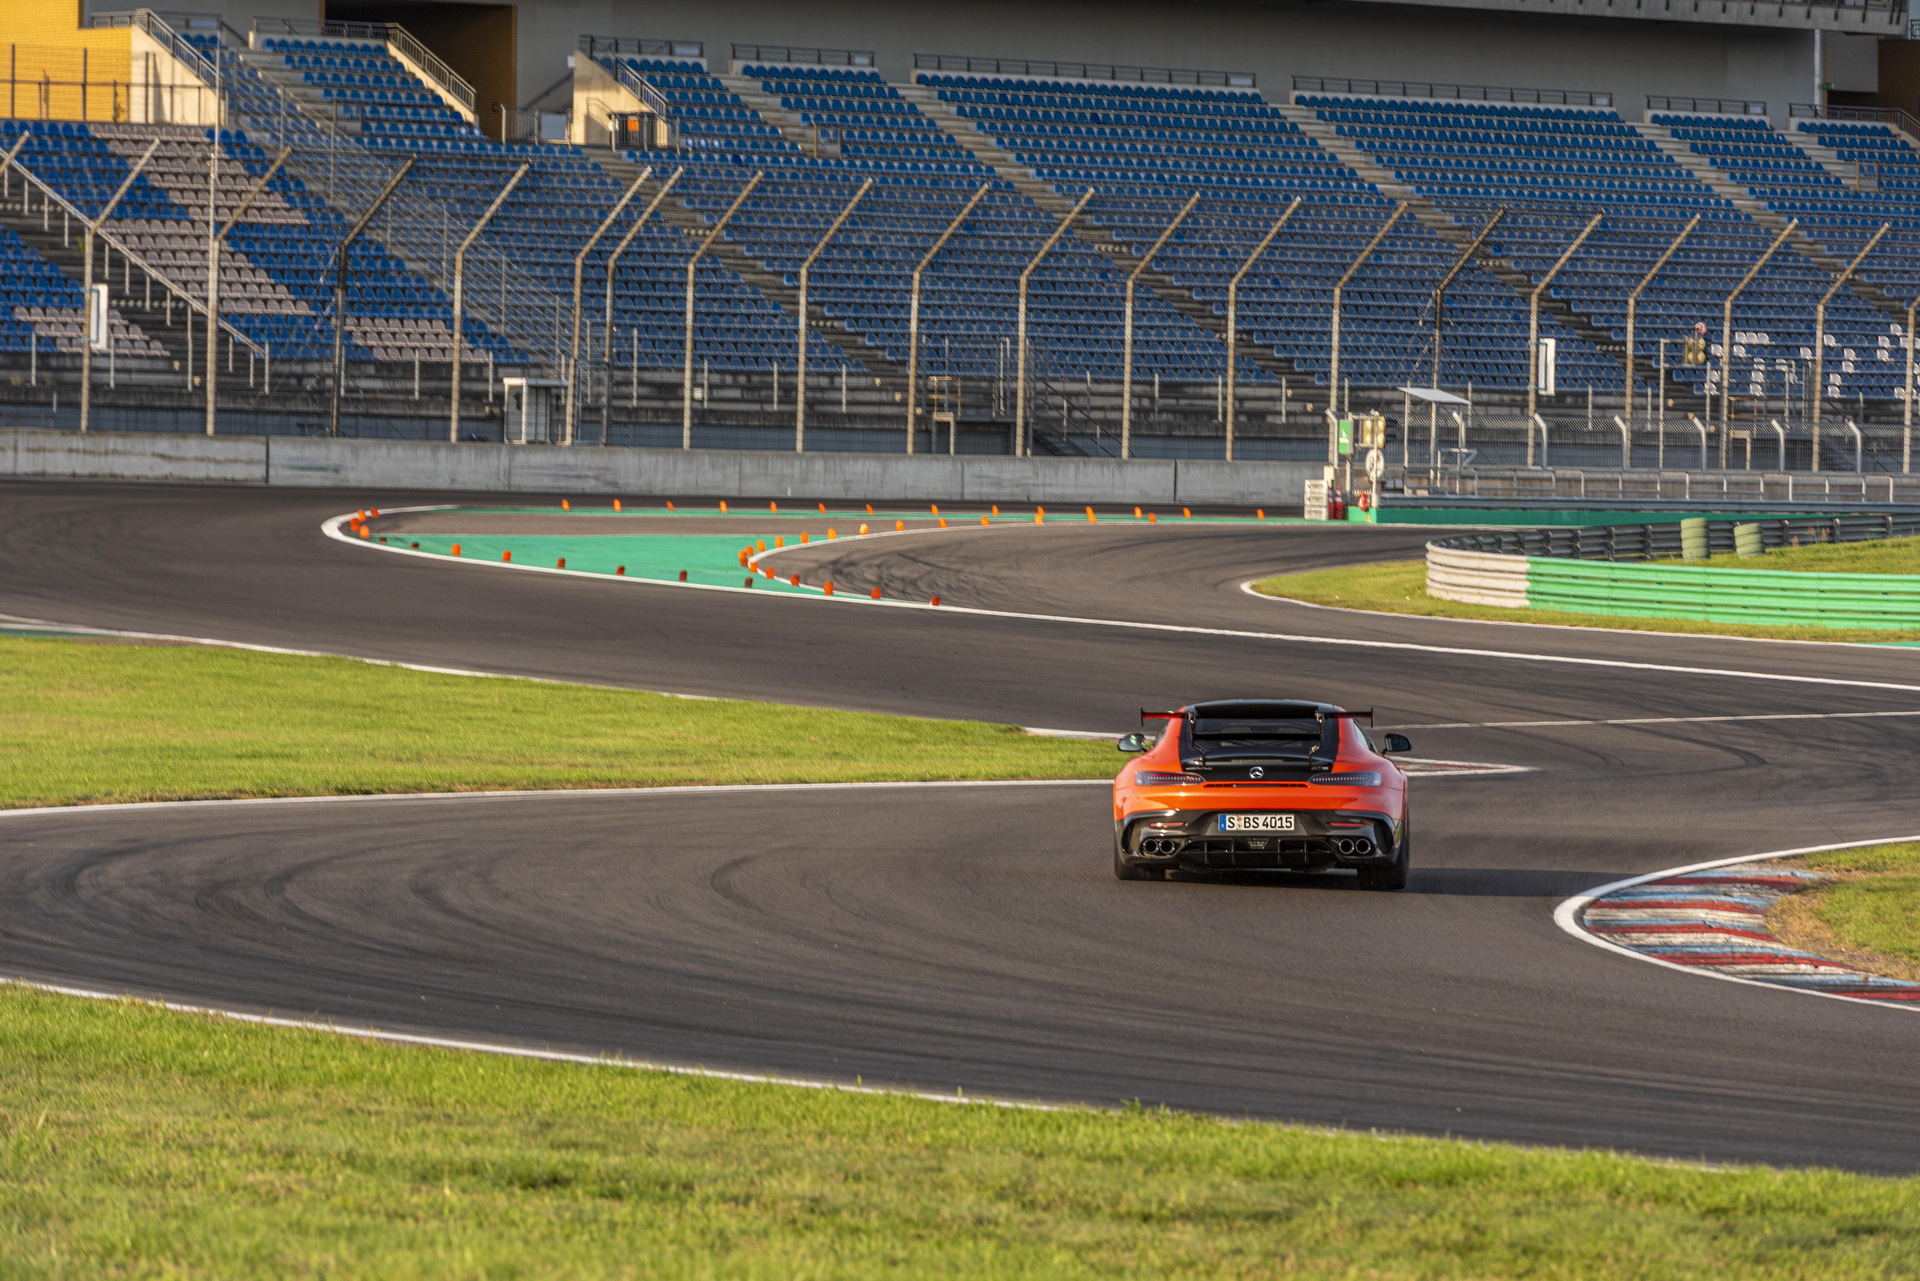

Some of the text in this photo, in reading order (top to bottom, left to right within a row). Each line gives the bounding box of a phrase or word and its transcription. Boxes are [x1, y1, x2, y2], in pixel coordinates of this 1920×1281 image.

[1227, 816, 1293, 829] S BS 4015
